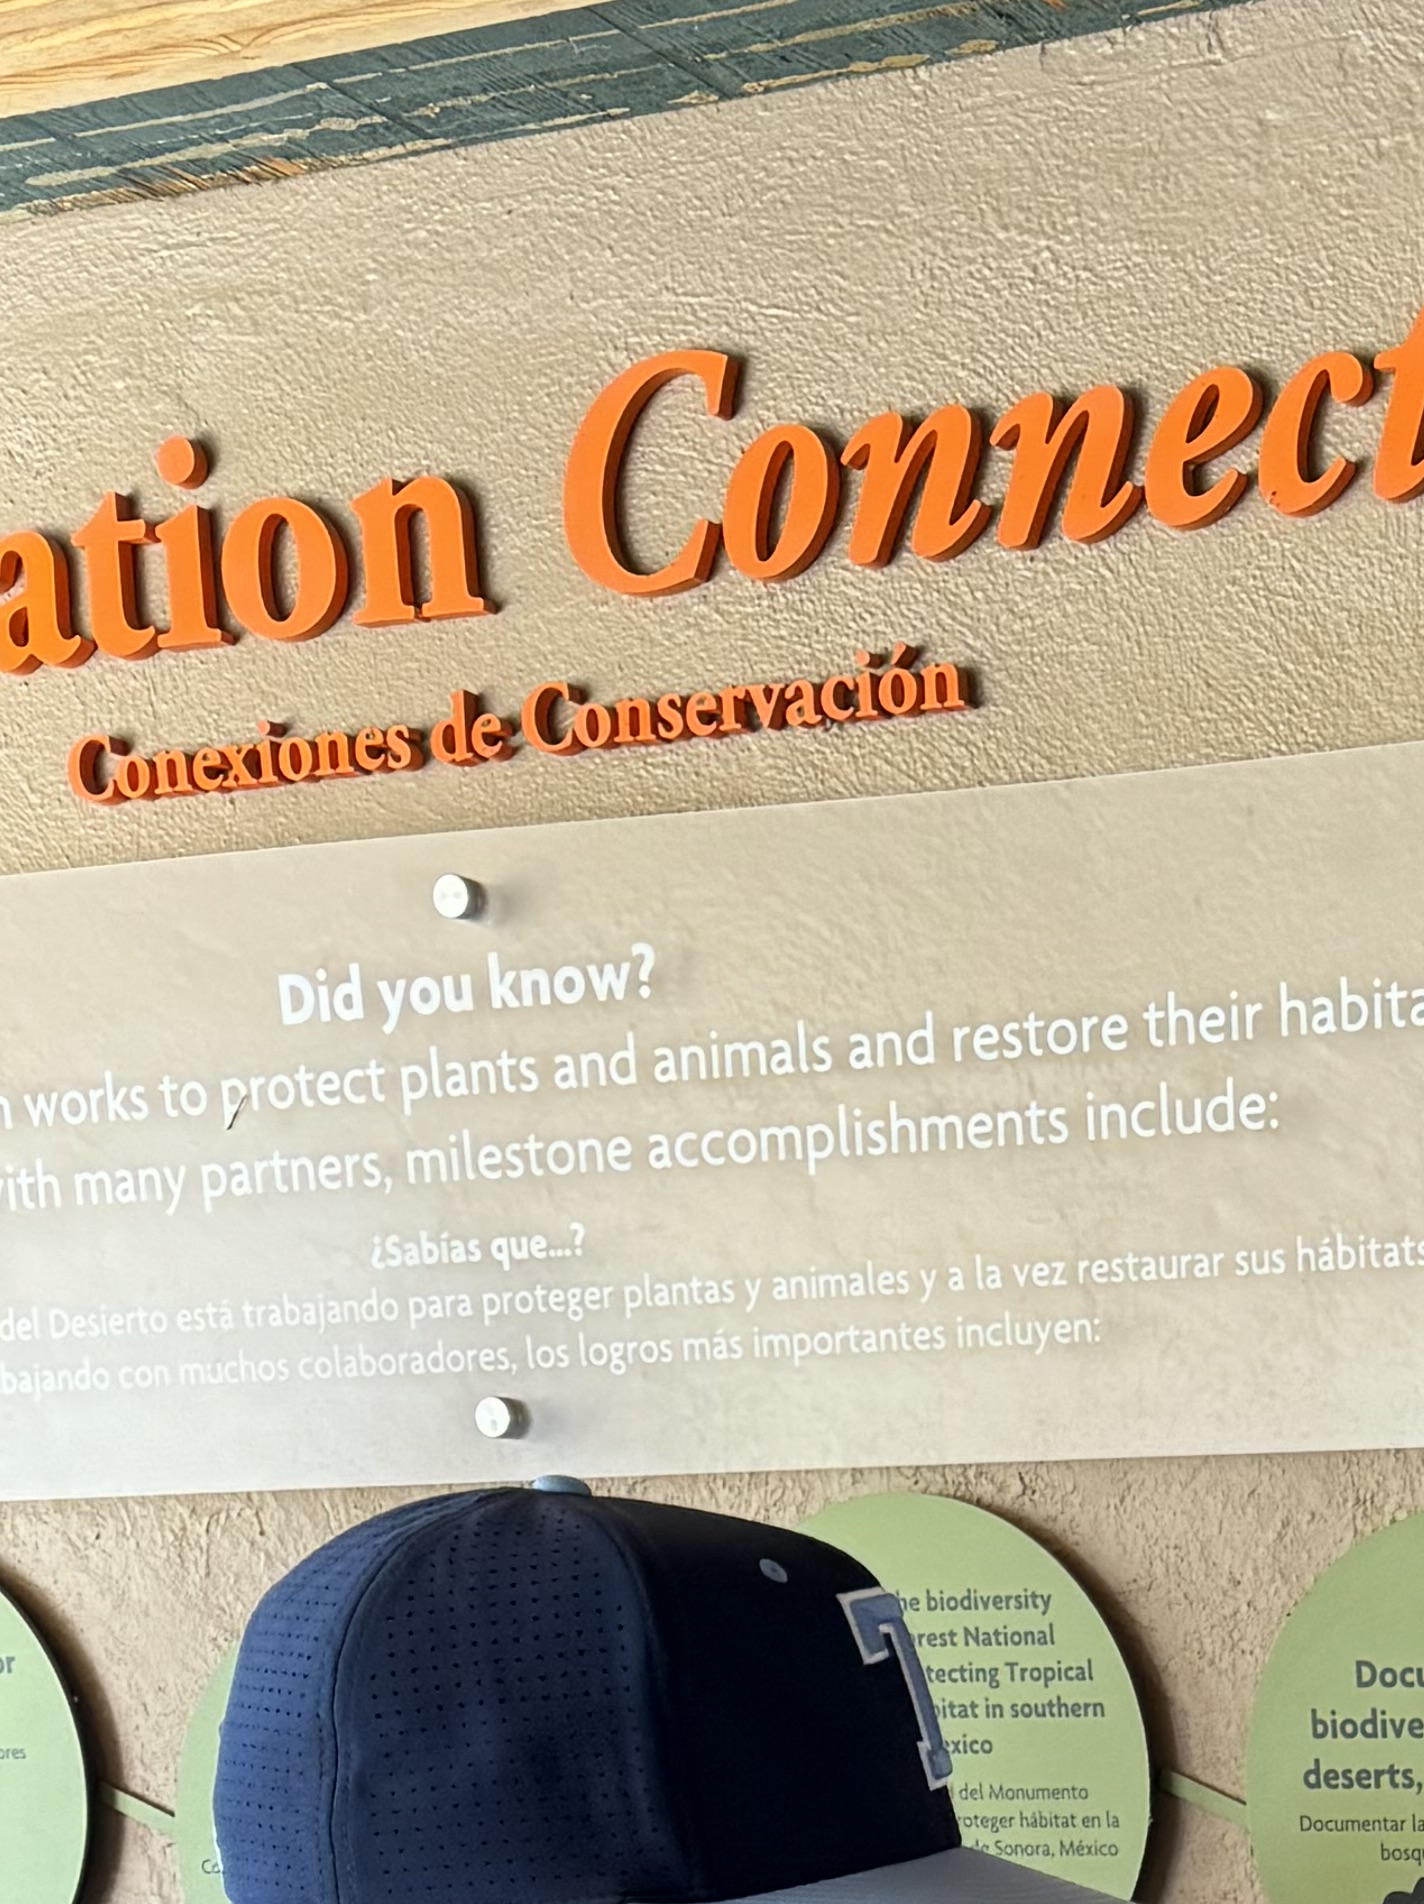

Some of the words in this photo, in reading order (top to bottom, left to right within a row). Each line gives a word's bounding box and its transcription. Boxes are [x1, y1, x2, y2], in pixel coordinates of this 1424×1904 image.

[68, 721, 413, 805] Conexiones
[429, 690, 509, 767] de
[519, 642, 970, 757] Conservación
[278, 962, 364, 1025] Did
[377, 974, 474, 1035] you
[487, 942, 655, 1009] know?
[23, 1070, 148, 1127] works
[158, 1075, 207, 1117] to
[221, 1059, 385, 1129] protect
[400, 1045, 539, 1116] plants
[554, 1031, 637, 1090] and
[653, 1019, 832, 1083] animals
[849, 1010, 935, 1070] and
[953, 1011, 1128, 1062] restore
[1142, 990, 1263, 1047] their
[0, 1158, 61, 1210] ith
[74, 1165, 186, 1215] many
[201, 1150, 392, 1212] partners,
[406, 1128, 632, 1184] milestone
[648, 1100, 1069, 1176] accomplishments
[1086, 1076, 1279, 1141] include:
[371, 1230, 482, 1269] ¿Sabías
[926, 1589, 1052, 1615] biodiversity
[964, 1623, 1055, 1647] National
[1005, 1659, 1094, 1687] Tropical
[985, 1699, 1004, 1720] in
[1010, 1698, 1105, 1719] southern
[1303, 1757, 1423, 1795] deserts,
[989, 1784, 1089, 1800] Monumento
[1299, 1814, 1407, 1833] Documentar
[1059, 1840, 1119, 1857] México
